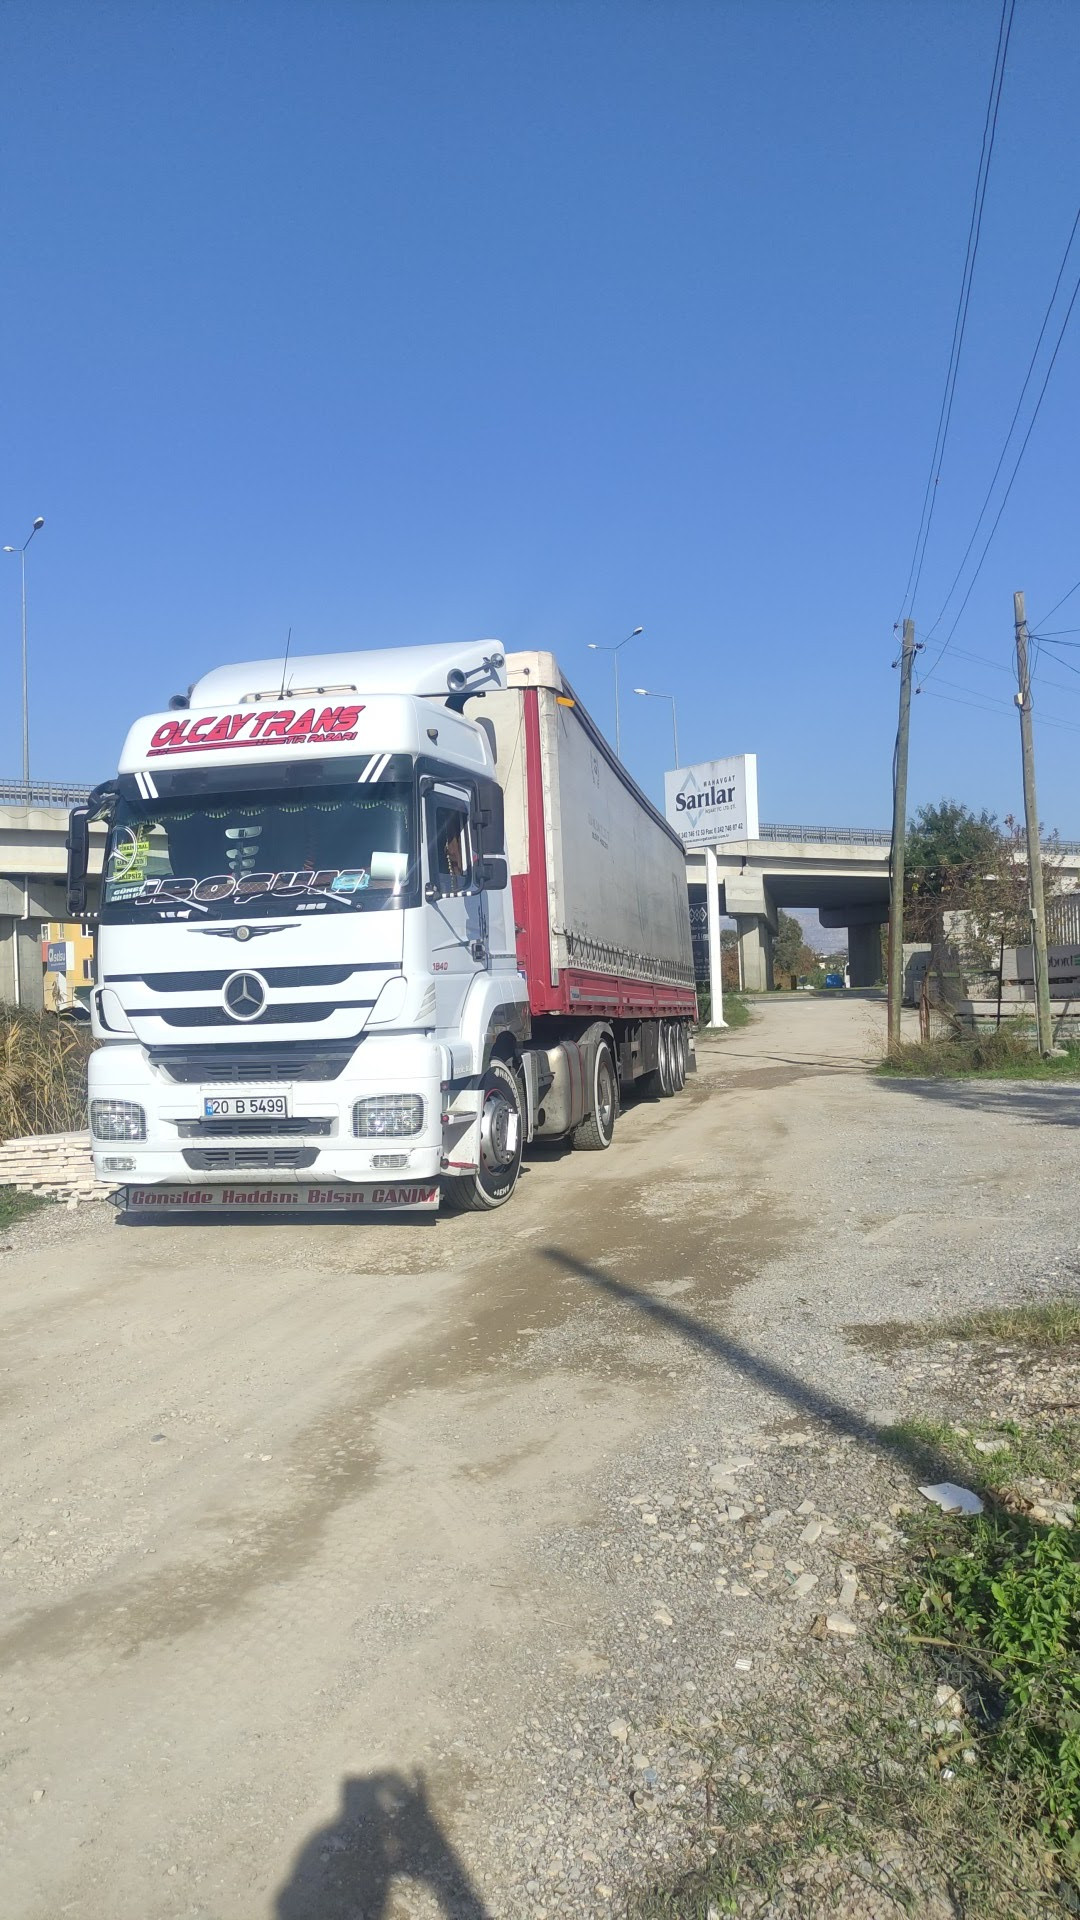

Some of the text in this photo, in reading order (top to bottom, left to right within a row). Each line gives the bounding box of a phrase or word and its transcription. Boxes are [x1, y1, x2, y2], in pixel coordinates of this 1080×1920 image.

[212, 1100, 229, 1114] 20
[236, 1100, 245, 1114] B
[250, 1099, 284, 1113] 5499
[307, 1189, 365, 1204] Bilsin
[371, 1187, 438, 1204] CANIM
